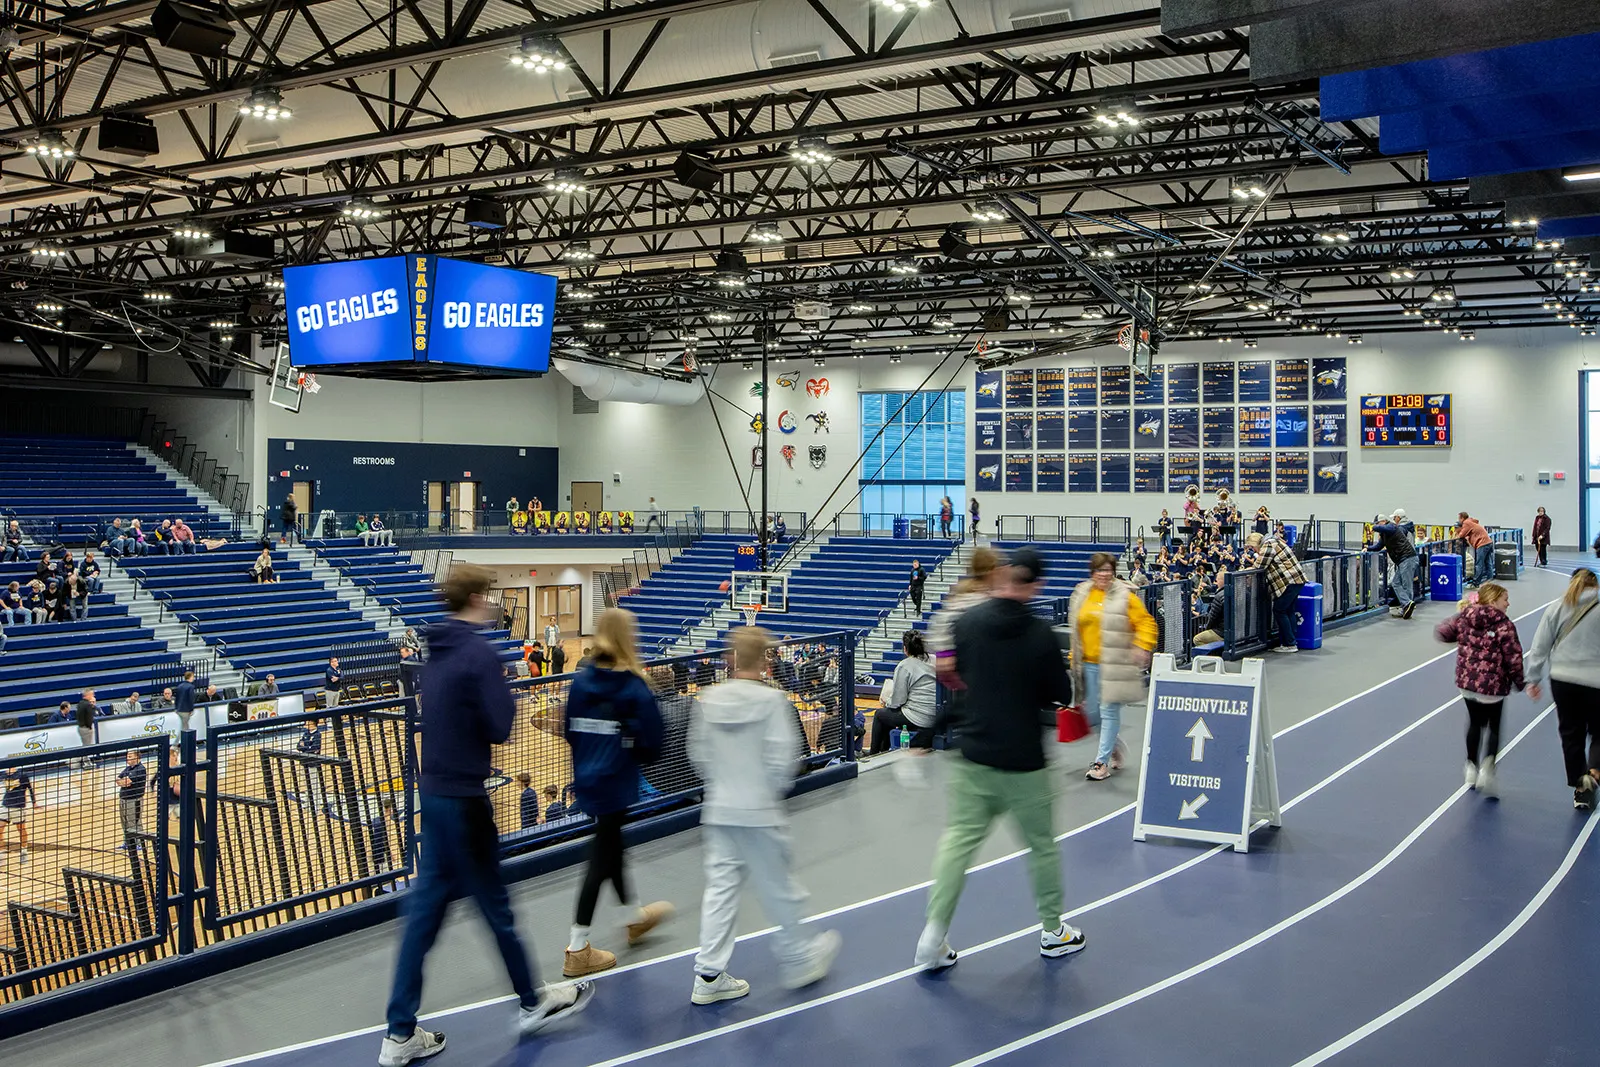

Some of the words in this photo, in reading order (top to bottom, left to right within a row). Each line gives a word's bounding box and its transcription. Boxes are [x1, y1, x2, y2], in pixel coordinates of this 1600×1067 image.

[415, 257, 428, 351] EAGLES
[296, 302, 323, 334] GO
[327, 287, 399, 328] EAGLES
[443, 301, 471, 329] GO
[475, 301, 544, 328] EAGLES
[1392, 395, 1422, 407] 13:08
[1376, 415, 1384, 427] 0
[1437, 414, 1445, 426] 0
[1368, 431, 1375, 441] 0
[1438, 430, 1445, 440] 0
[352, 456, 395, 466] RESTROOMS
[737, 546, 755, 555] 13:08
[1157, 695, 1249, 716] HUDSONVILLE
[1168, 773, 1221, 790] VISITORS
